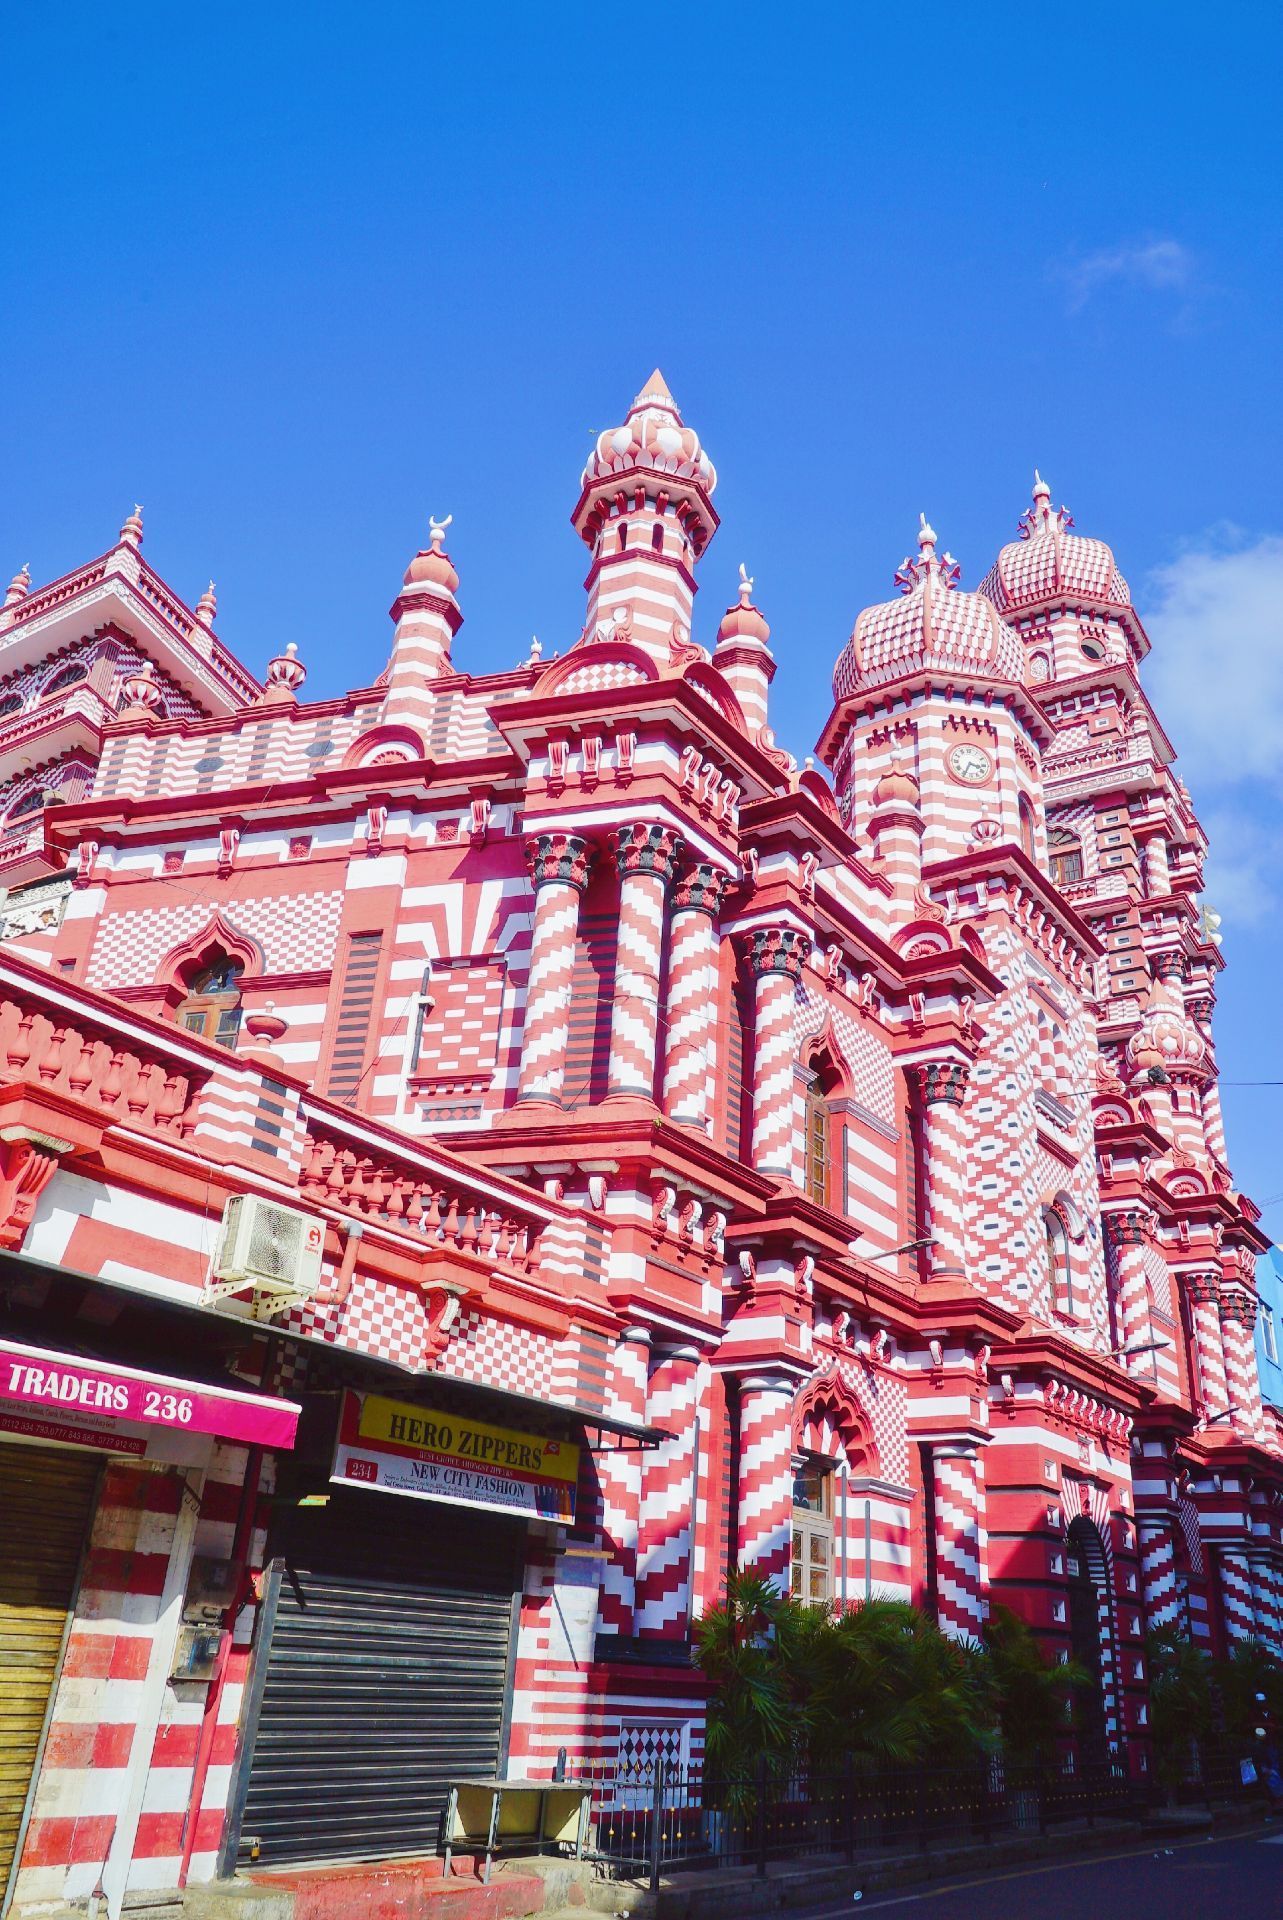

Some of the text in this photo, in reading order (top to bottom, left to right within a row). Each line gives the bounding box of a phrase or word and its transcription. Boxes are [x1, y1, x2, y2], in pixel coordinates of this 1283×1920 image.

[8, 1363, 129, 1410] TRADERS
[143, 1391, 193, 1423] 236
[388, 1414, 542, 1470] HERO ZIPPERS
[351, 1462, 372, 1479] 234
[410, 1462, 440, 1481] NEW
[443, 1468, 473, 1488] CITY
[475, 1474, 526, 1498] FASHION
